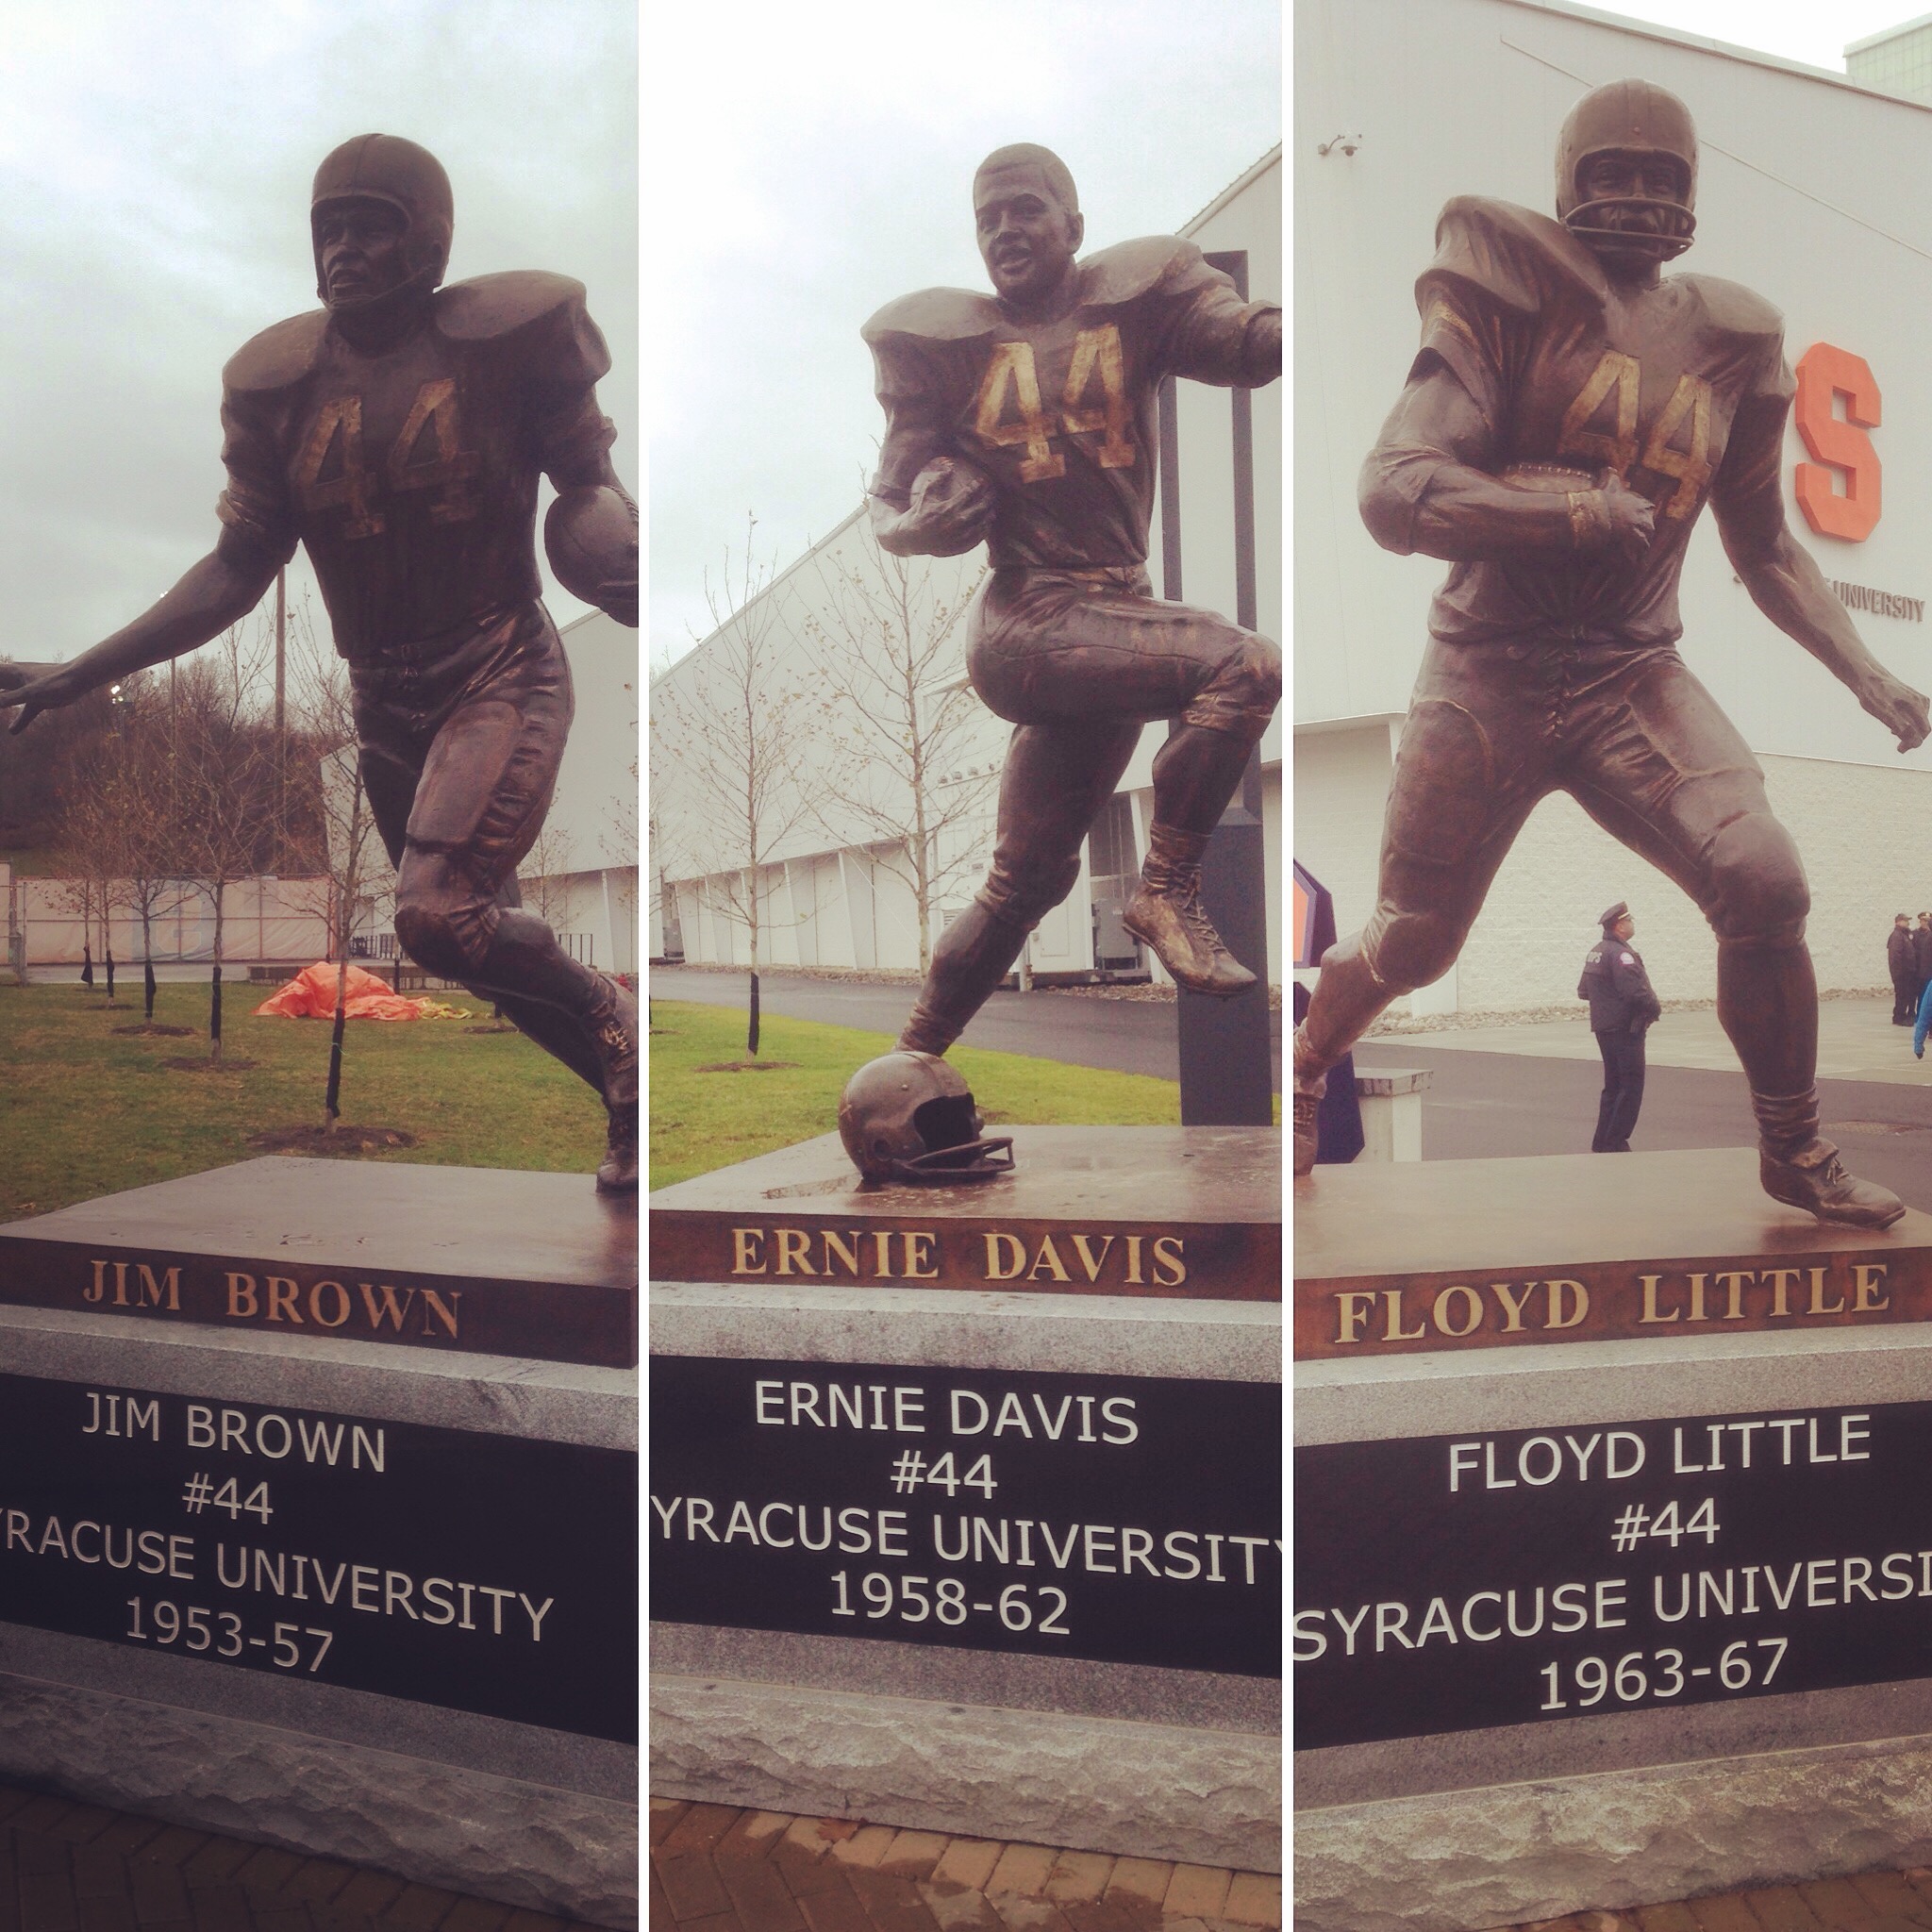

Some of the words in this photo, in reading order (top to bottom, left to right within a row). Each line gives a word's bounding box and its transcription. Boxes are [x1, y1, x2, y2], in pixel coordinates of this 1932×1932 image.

[974, 323, 1136, 483] 44
[290, 377, 477, 540] 44
[1795, 341, 1882, 543] S
[731, 1229, 939, 1278] ERNIE
[983, 1233, 1188, 1286] DAVIS
[83, 1260, 182, 1312] JIM
[225, 1272, 462, 1340] BROWN
[1335, 1280, 1590, 1343] FLOYD
[1639, 1265, 1890, 1324] LITTLE
[82, 1392, 159, 1441] JIM
[188, 1405, 386, 1473] BROWN
[756, 1380, 925, 1433] ERNIE
[951, 1390, 1139, 1444] DAVIS
[890, 1449, 998, 1500] #44
[1449, 1433, 1646, 1492] FLOYD
[1674, 1415, 1871, 1474] LITTLE
[182, 1472, 274, 1524] #44
[650, 1494, 908, 1557] YRACUSE
[1610, 1497, 1721, 1553] #44
[0, 1507, 194, 1581] RACUSE
[217, 1542, 555, 1642] UNIVERSITY
[830, 1571, 1071, 1635] 1958-62
[1293, 1579, 1627, 1661] SYRACUSE
[1655, 1551, 1932, 1624] UNIVERSI
[126, 1596, 334, 1673] 1953-57
[1540, 1638, 1789, 1710] 1963-67
